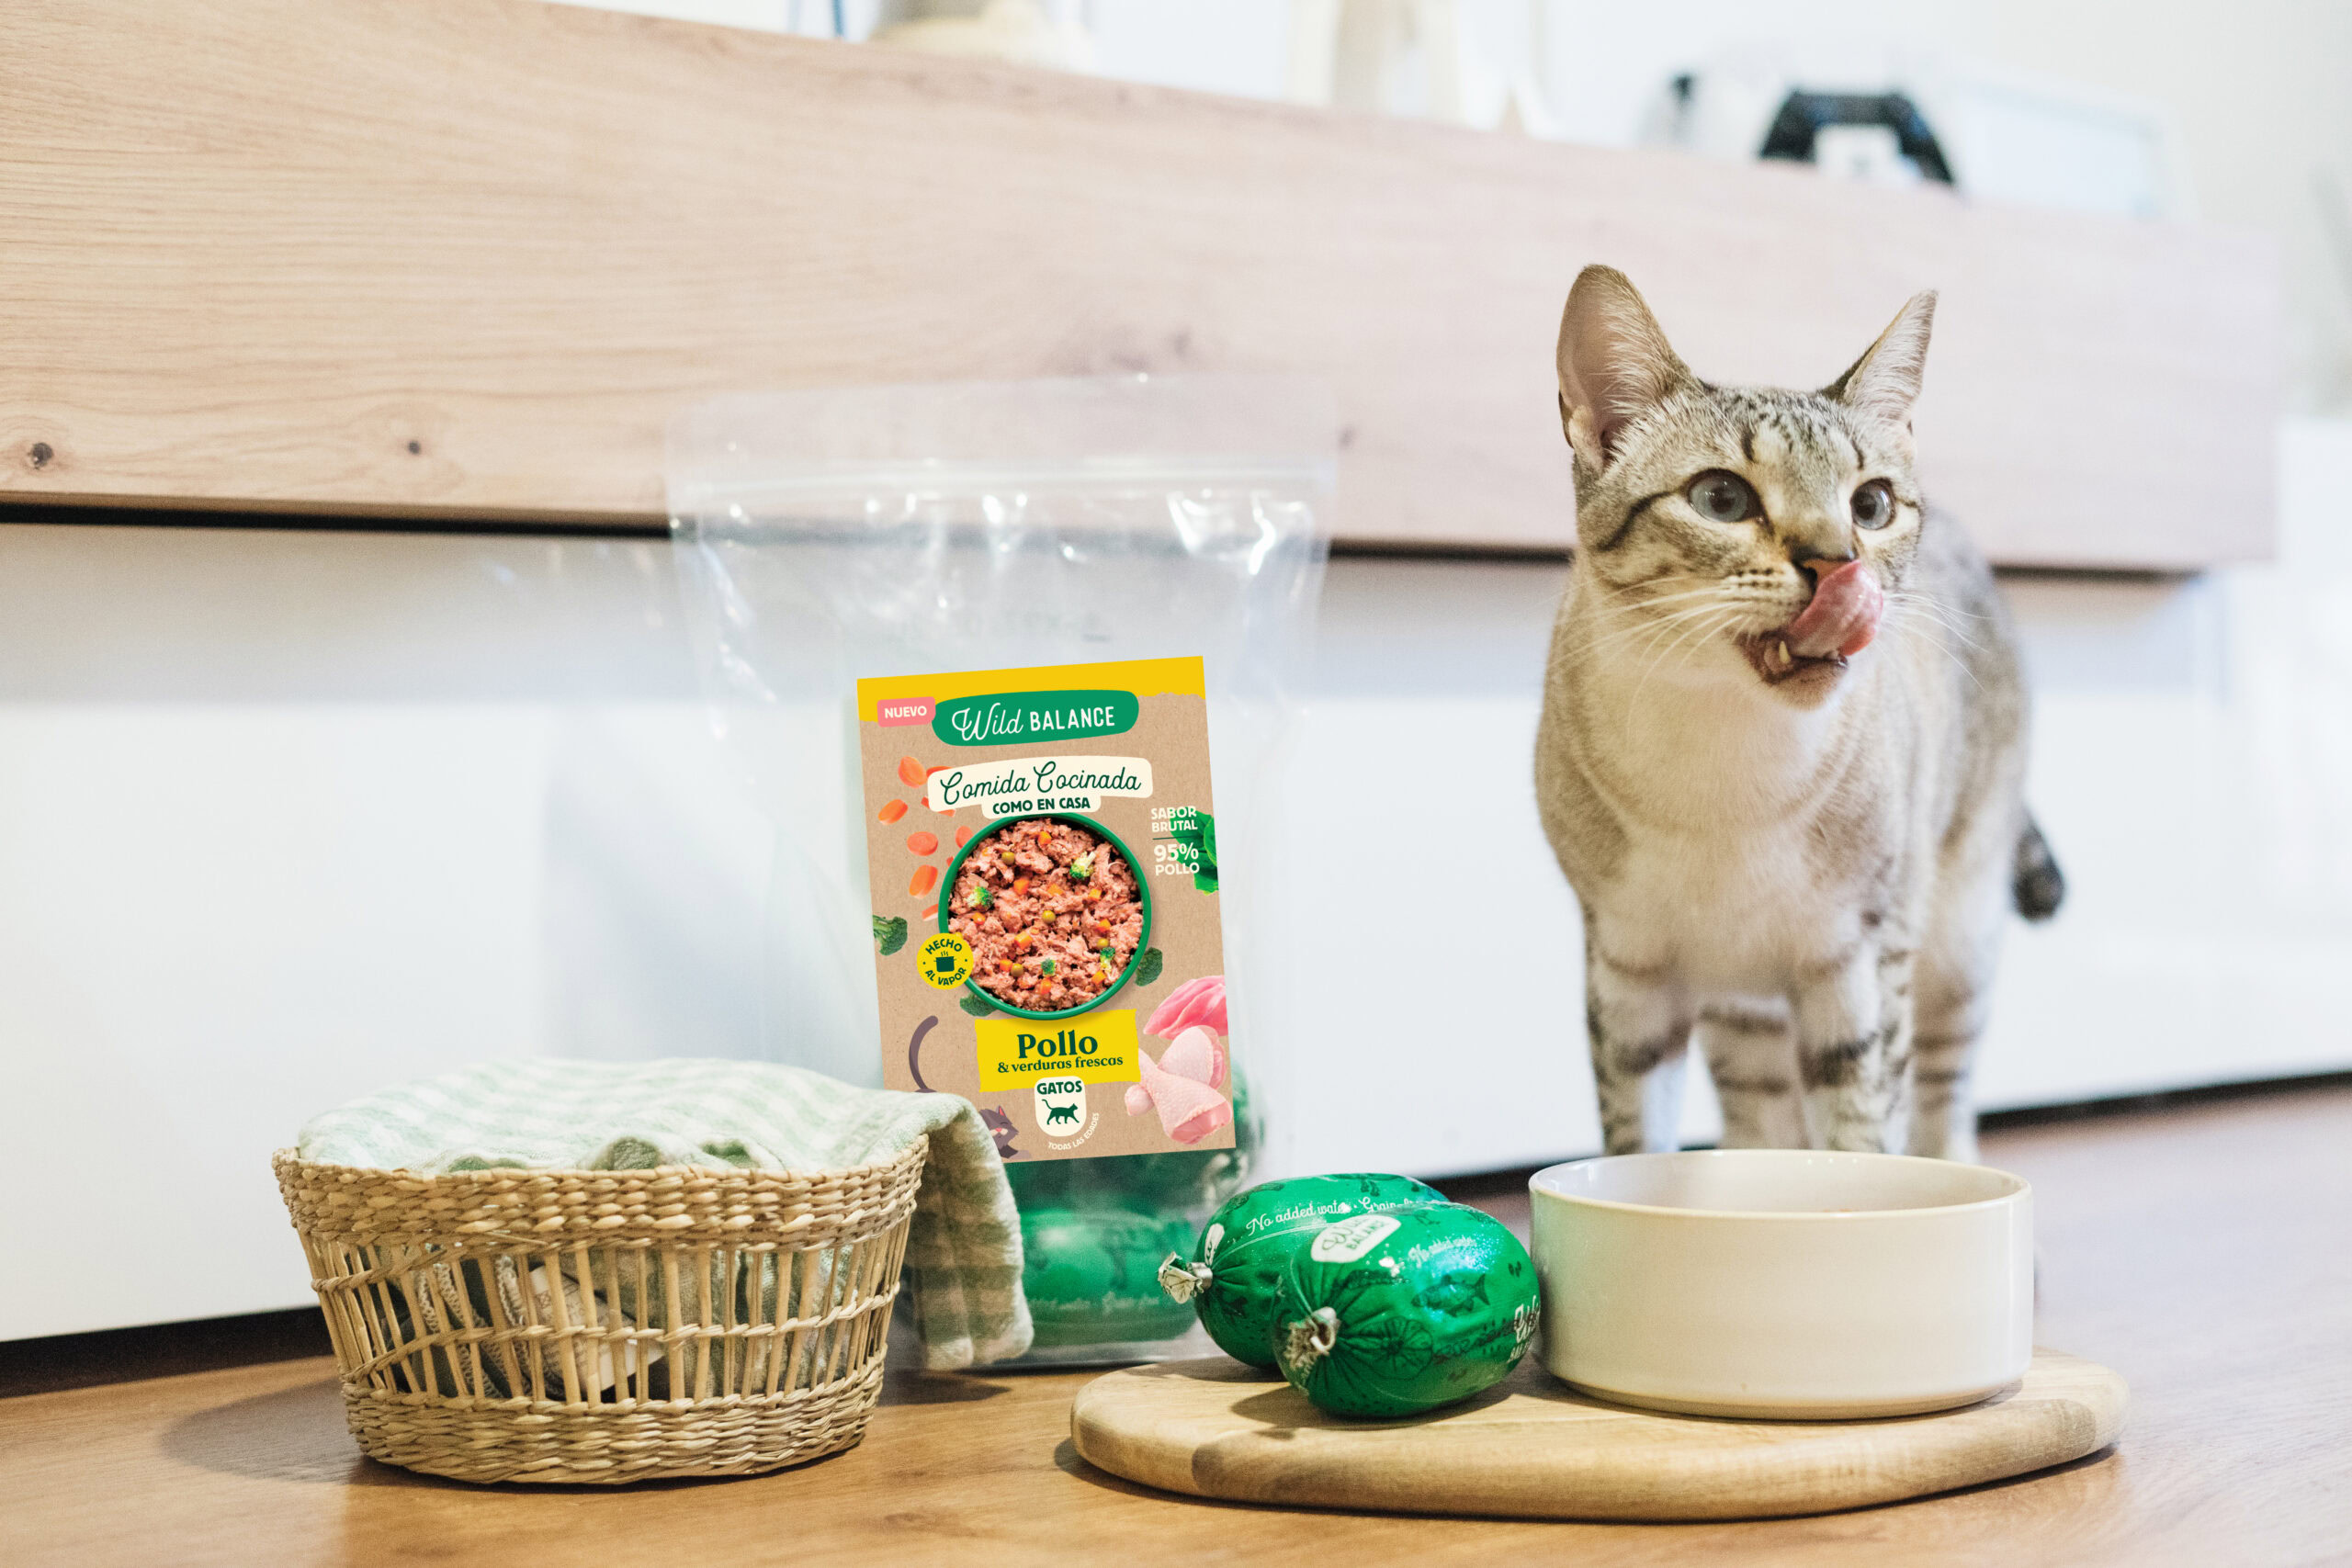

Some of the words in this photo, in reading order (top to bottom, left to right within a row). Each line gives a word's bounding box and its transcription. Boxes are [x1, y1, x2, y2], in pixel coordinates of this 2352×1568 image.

[885, 705, 927, 718] NUEVO
[952, 703, 1023, 740] Wild
[1030, 706, 1114, 731] BALANCE
[940, 770, 1030, 805] Comida
[1034, 761, 1141, 793] Cocinada
[992, 800, 1033, 814] COMO
[1037, 798, 1055, 810] EN
[1059, 797, 1091, 809] CASA
[1150, 806, 1197, 820] SABOR
[1151, 819, 1198, 832] BRUTAL
[1154, 842, 1199, 863] 95%
[1155, 862, 1200, 876] POLLO
[925, 939, 962, 954] HECHO
[925, 970, 935, 981] AL
[938, 967, 967, 986] VAPOR
[1017, 1030, 1098, 1058] Pollo
[998, 1062, 1009, 1073] &
[1011, 1059, 1072, 1072] verduras
[1075, 1056, 1123, 1068] frescas
[1036, 1080, 1082, 1095] GATOS
[1048, 1142, 1071, 1150] TODAS
[1072, 1136, 1084, 1147] LAS
[1084, 1112, 1100, 1139] EDADES
[1246, 1213, 1273, 1236] No
[1275, 1203, 1316, 1224] added
[1317, 1200, 1351, 1214] wate
